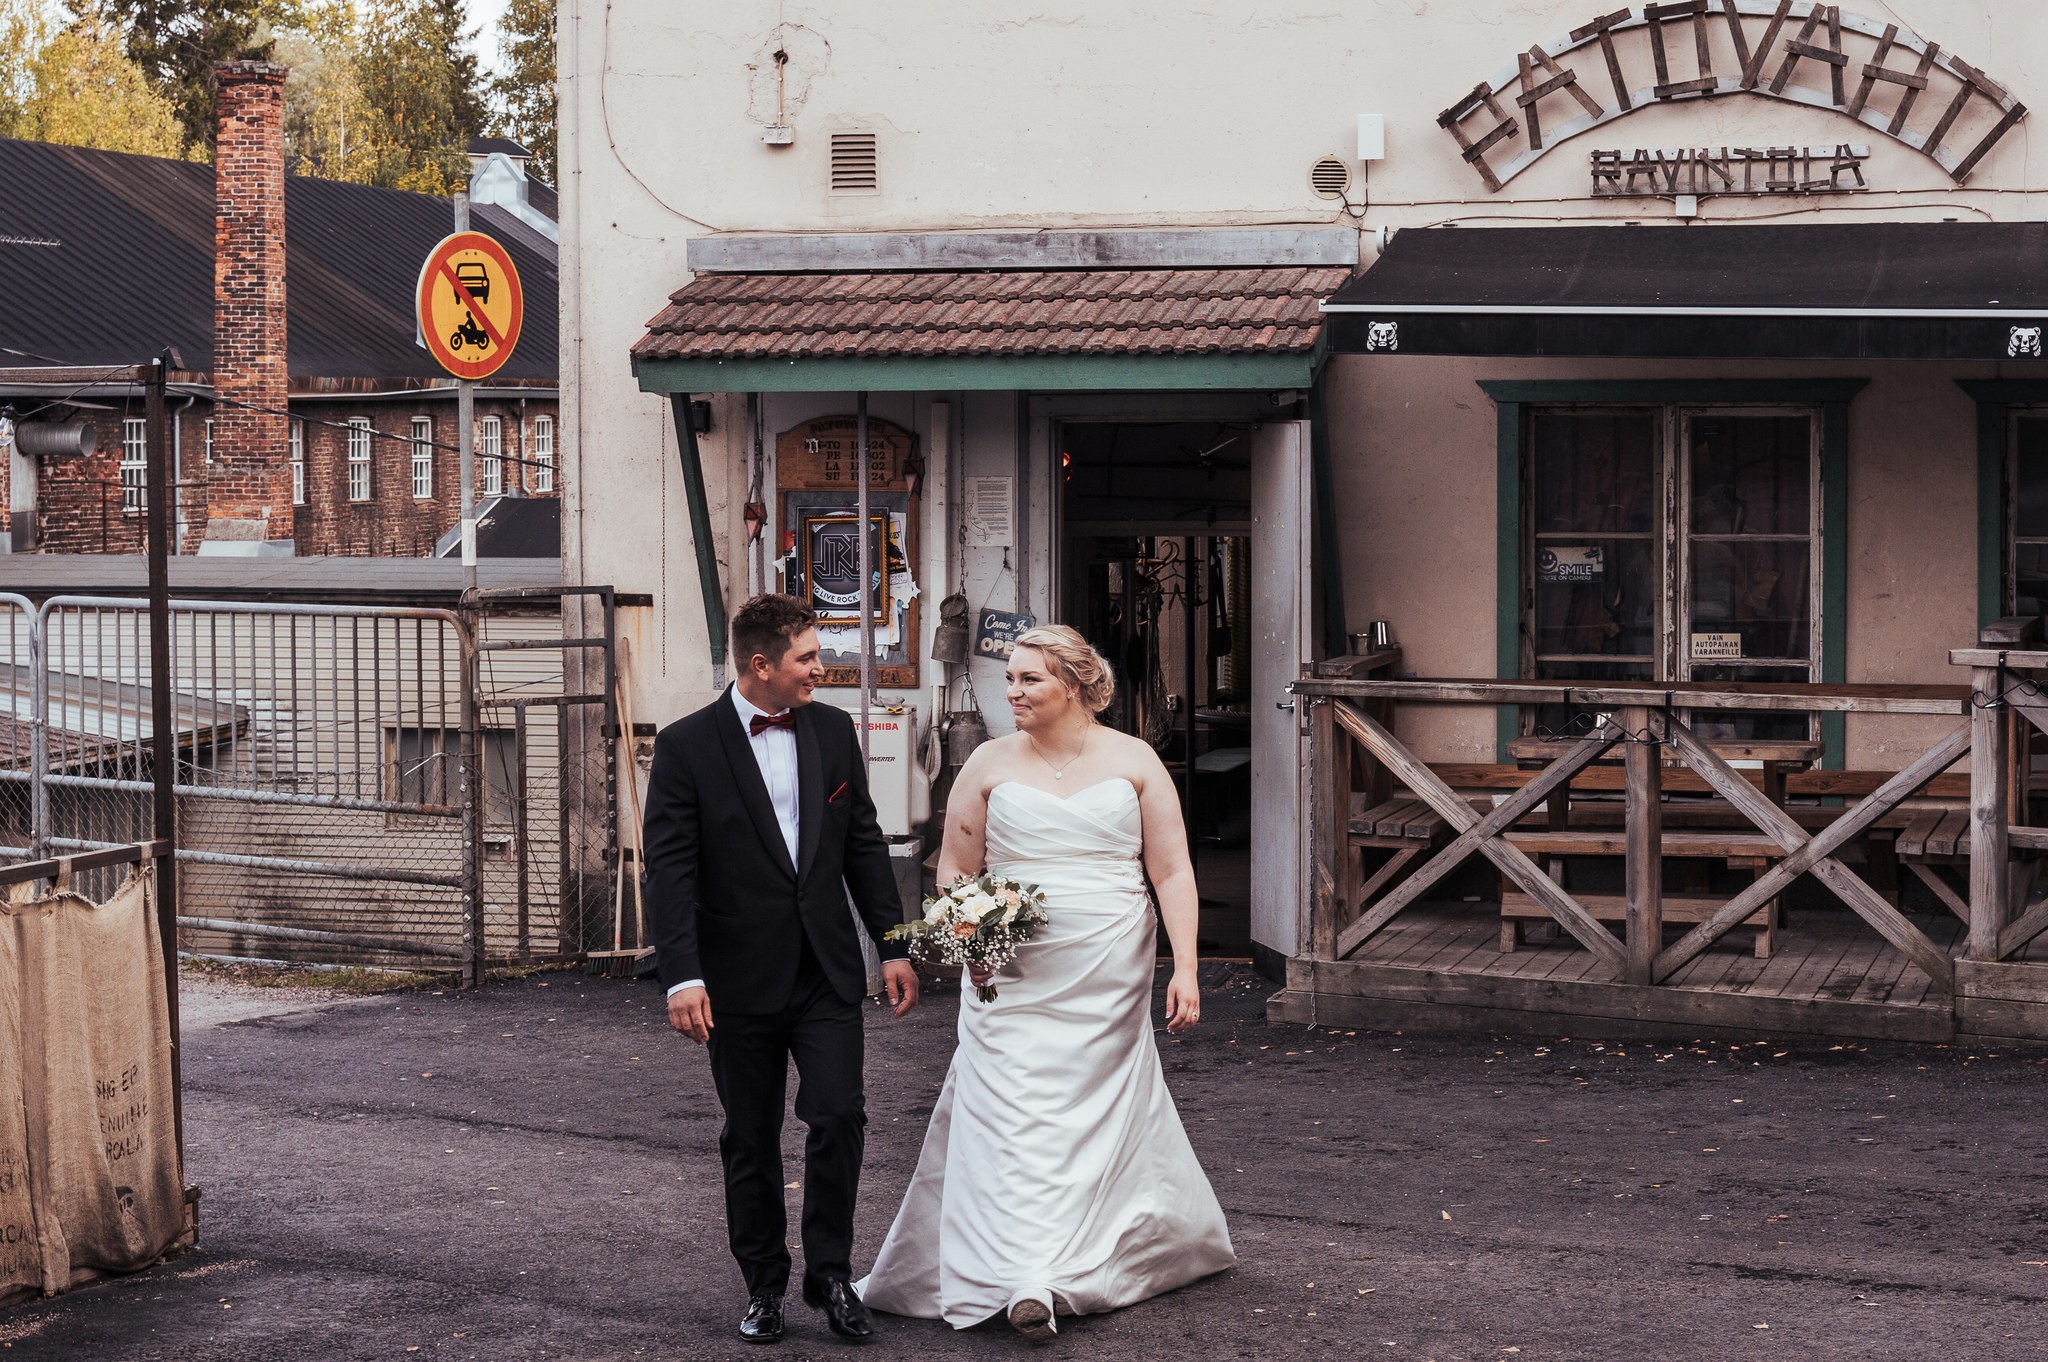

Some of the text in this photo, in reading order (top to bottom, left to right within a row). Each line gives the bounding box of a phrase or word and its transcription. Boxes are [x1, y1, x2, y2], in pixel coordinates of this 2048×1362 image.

[1436, 0, 2028, 193] PATOVAHTI
[1590, 143, 1864, 194] RAVINTOLA
[826, 451, 841, 460] PE
[825, 462, 840, 471] LA
[825, 472, 840, 481] SU
[1559, 565, 1592, 576] SMILE
[820, 592, 836, 603] LIVE
[836, 594, 858, 603] ROCK
[984, 613, 1028, 633] Come In
[993, 630, 1014, 641] WE'RE
[980, 636, 1015, 656] OPE
[1694, 648, 1740, 656] VARANNEILLE
[854, 722, 899, 731] TSHIBA
